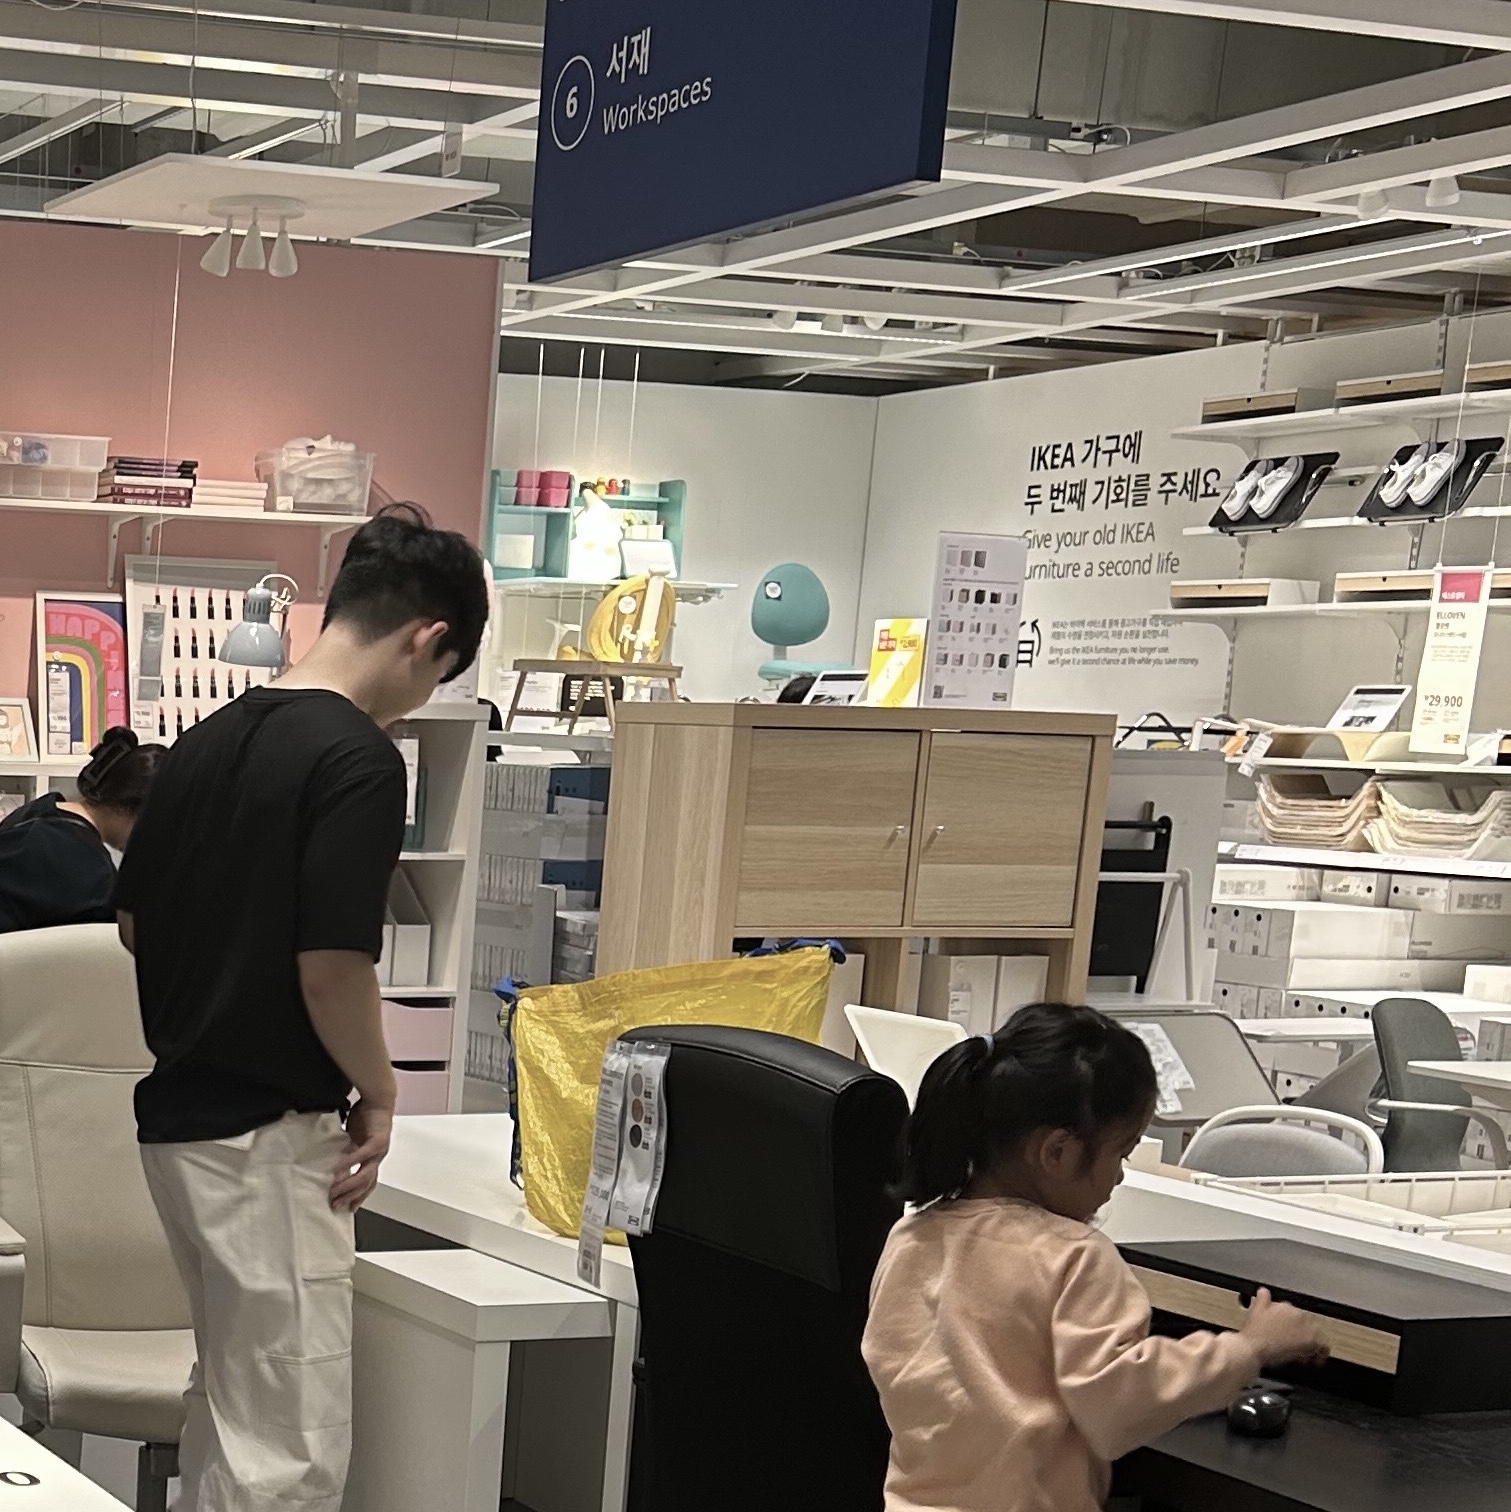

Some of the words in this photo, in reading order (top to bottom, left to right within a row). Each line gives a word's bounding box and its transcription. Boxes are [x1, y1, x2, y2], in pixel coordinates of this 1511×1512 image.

[605, 25, 652, 84] 서재
[564, 86, 579, 119] 6
[602, 75, 713, 136] Workspaces
[1029, 442, 1075, 472] IKEA
[1080, 430, 1143, 469] 가구에
[1024, 484, 1043, 516] 두
[1049, 478, 1087, 513] 번째
[1091, 472, 1152, 510] 기회를
[1157, 467, 1222, 506] 주세요
[1055, 528, 1089, 554] your
[1092, 523, 1117, 546] old
[1120, 521, 1156, 545] IKEA
[1084, 561, 1093, 578] a
[1097, 551, 1153, 578] second
[1156, 550, 1180, 575] life
